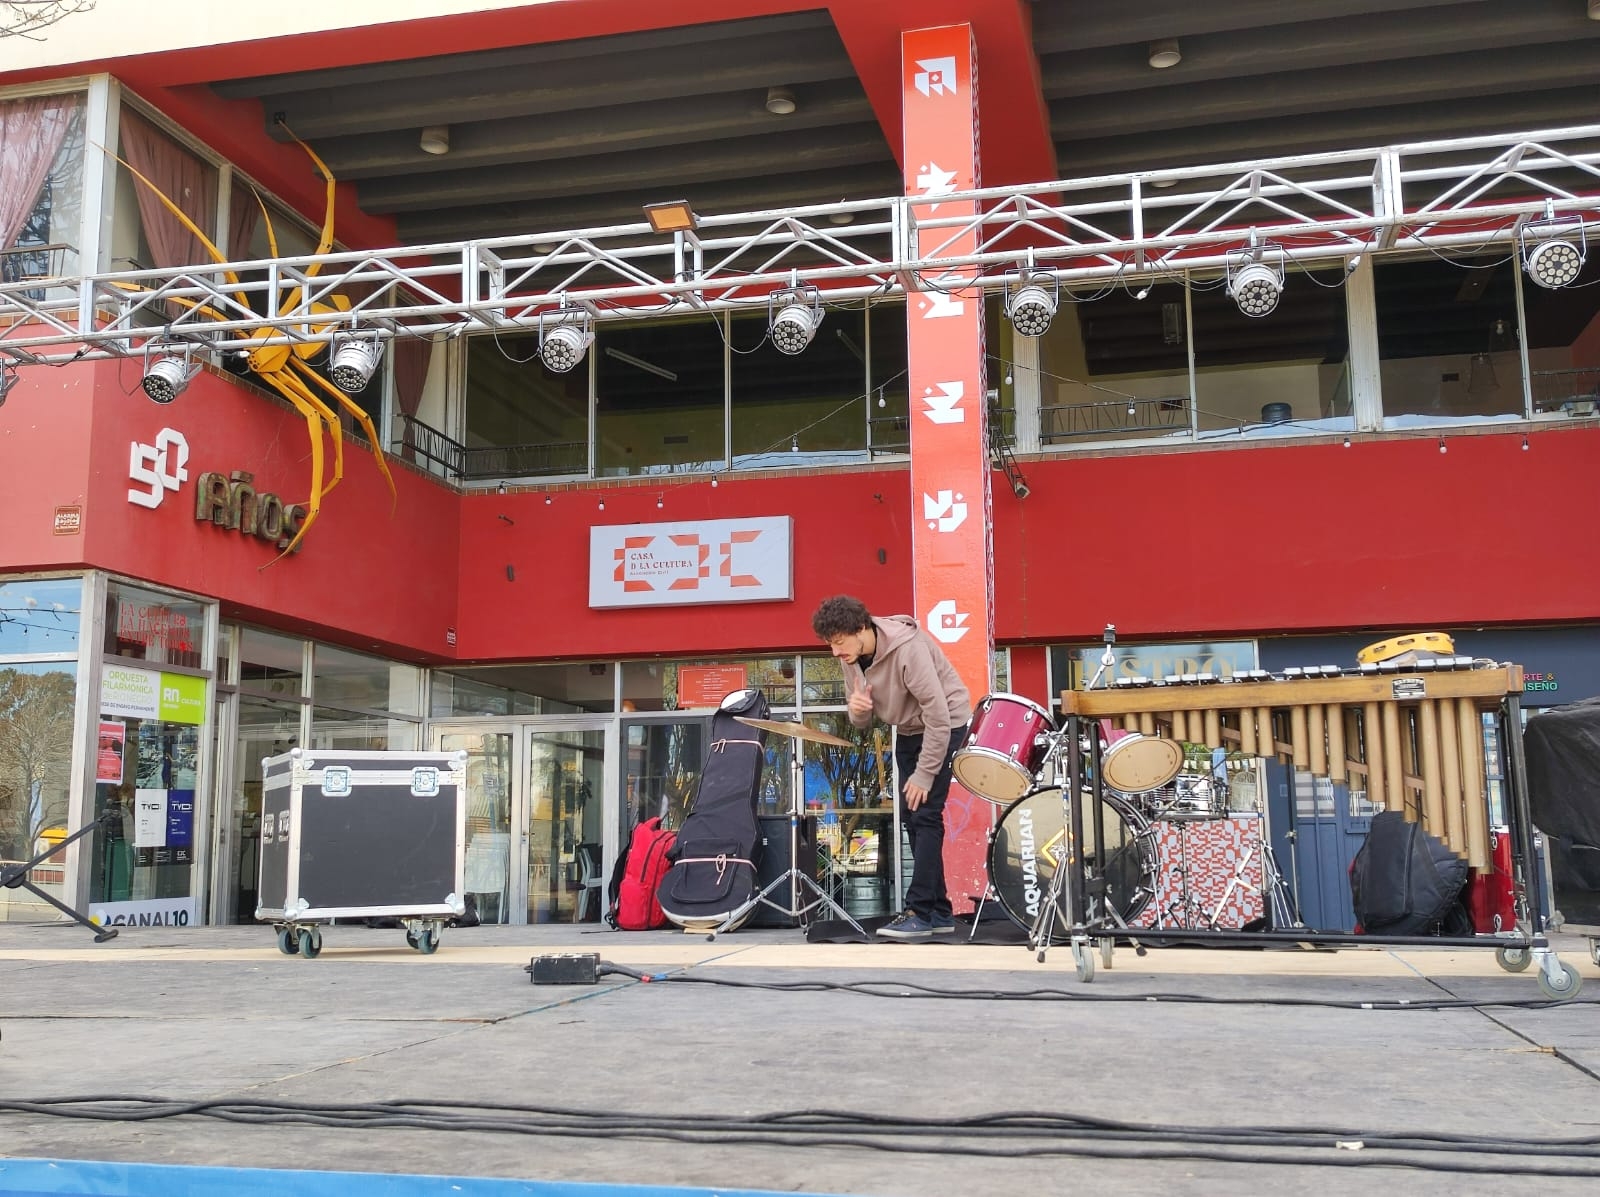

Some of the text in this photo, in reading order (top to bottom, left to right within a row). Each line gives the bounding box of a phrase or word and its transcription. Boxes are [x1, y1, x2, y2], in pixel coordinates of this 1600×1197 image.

[630, 552, 654, 560] CASA
[639, 562, 650, 570] LA
[653, 560, 692, 568] CULTURA
[109, 670, 149, 683] ORQUESTA
[1523, 673, 1543, 681] RTE
[1523, 680, 1558, 691] ISEÑO
[1019, 808, 1042, 917] AQUARIAN
